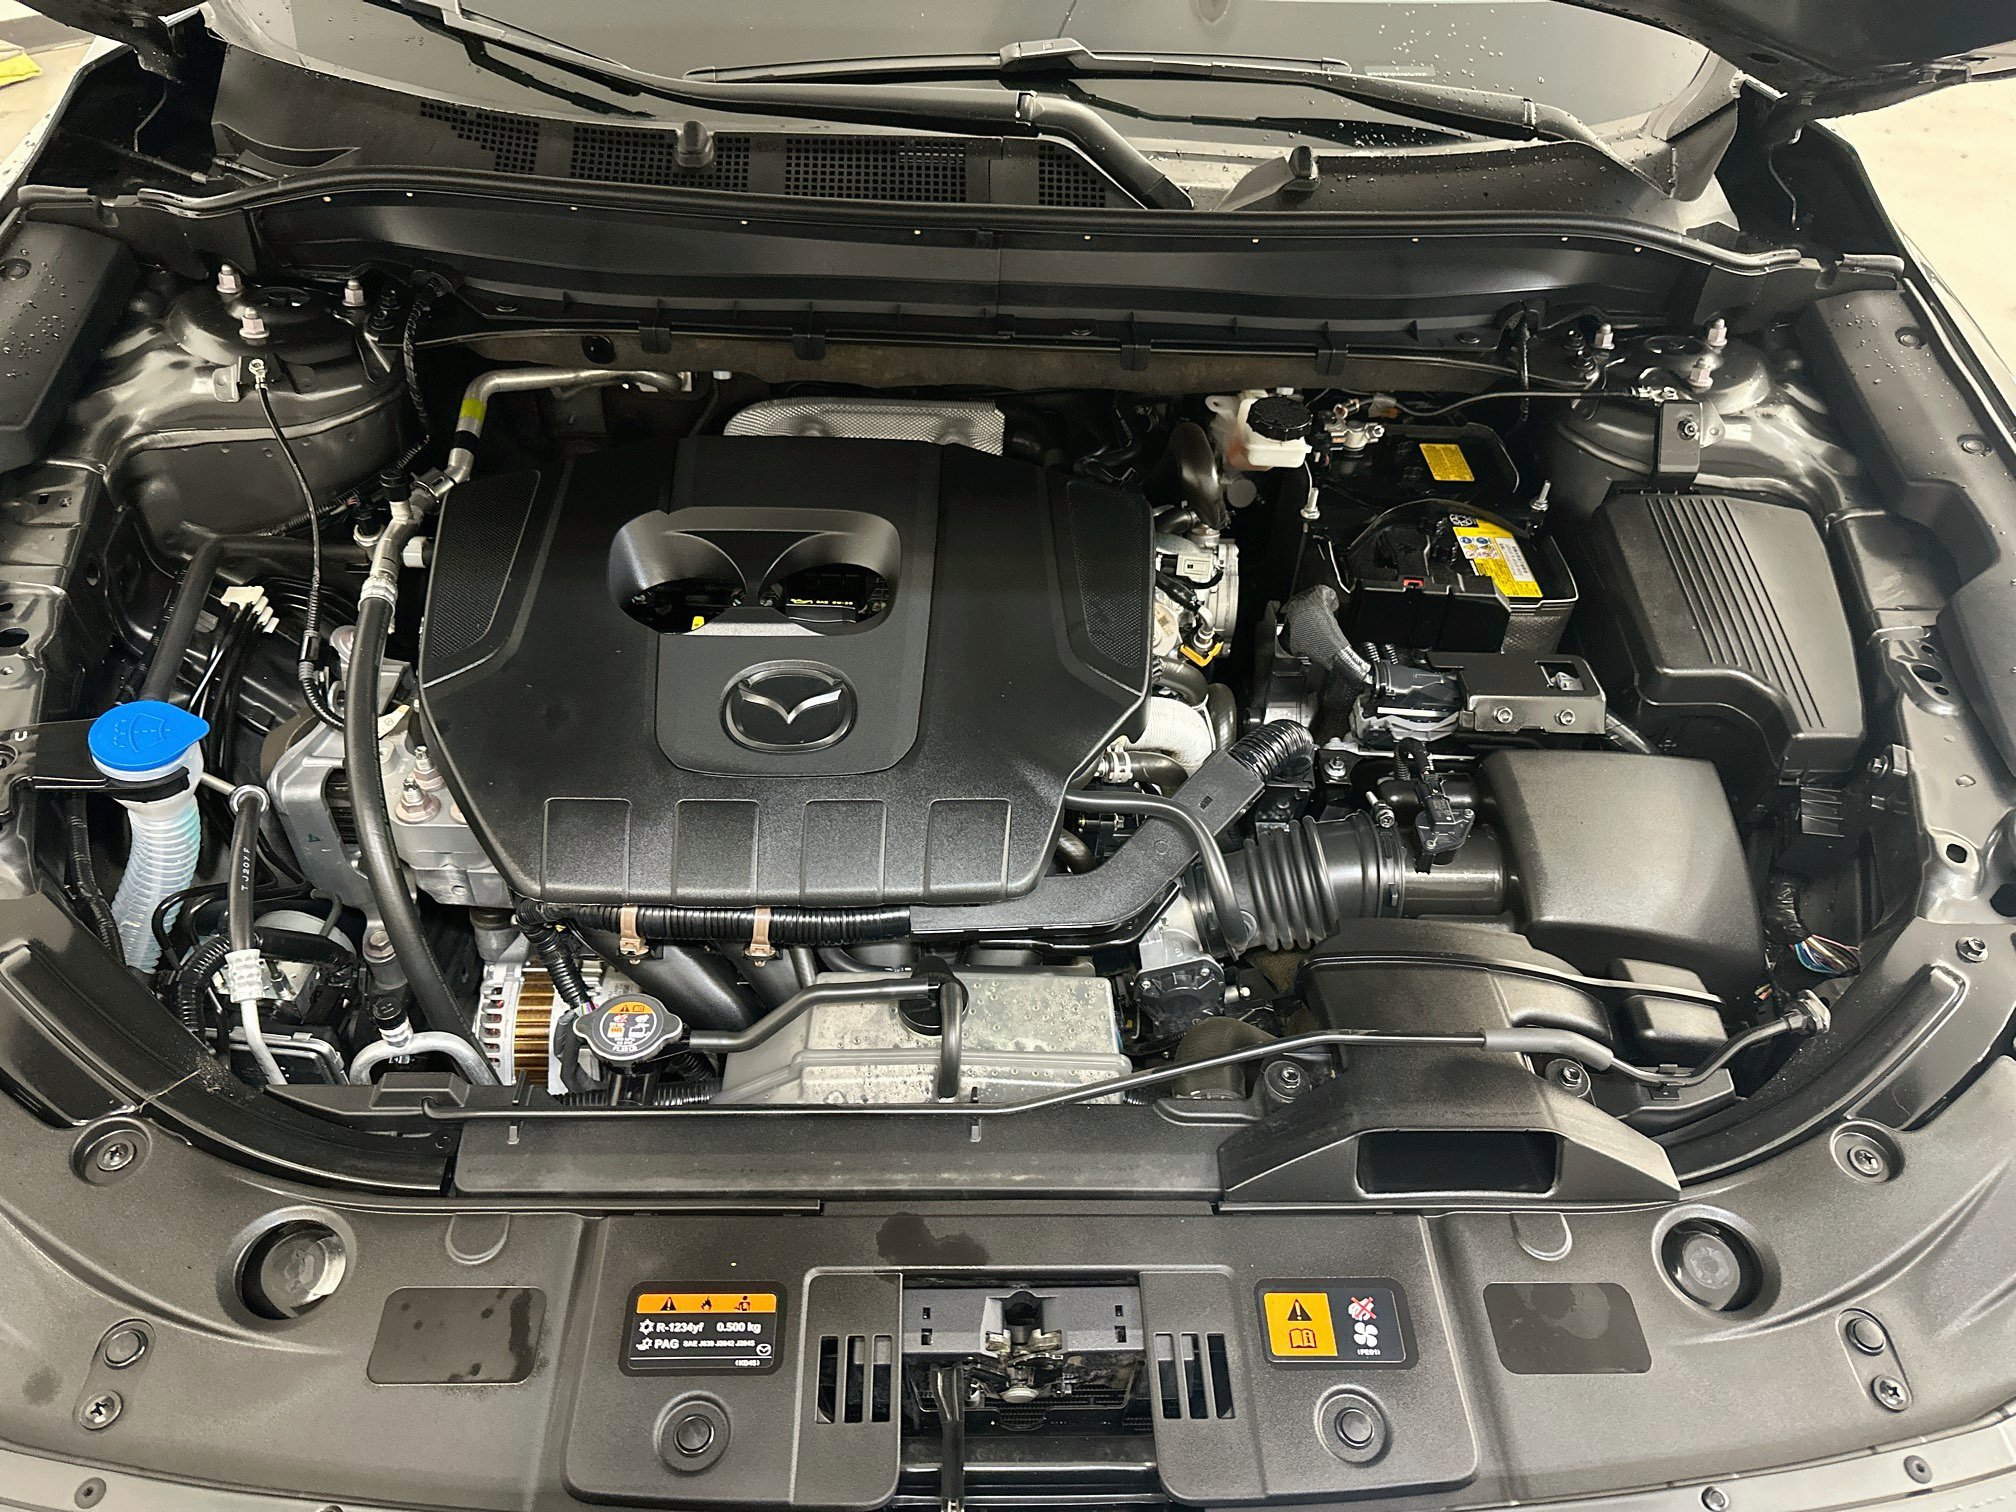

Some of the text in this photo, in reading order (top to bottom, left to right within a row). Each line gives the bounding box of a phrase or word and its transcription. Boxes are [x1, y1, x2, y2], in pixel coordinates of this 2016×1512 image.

[655, 1321, 762, 1335] R-1234yf 0.500 kg
[653, 1338, 680, 1349] PAG
